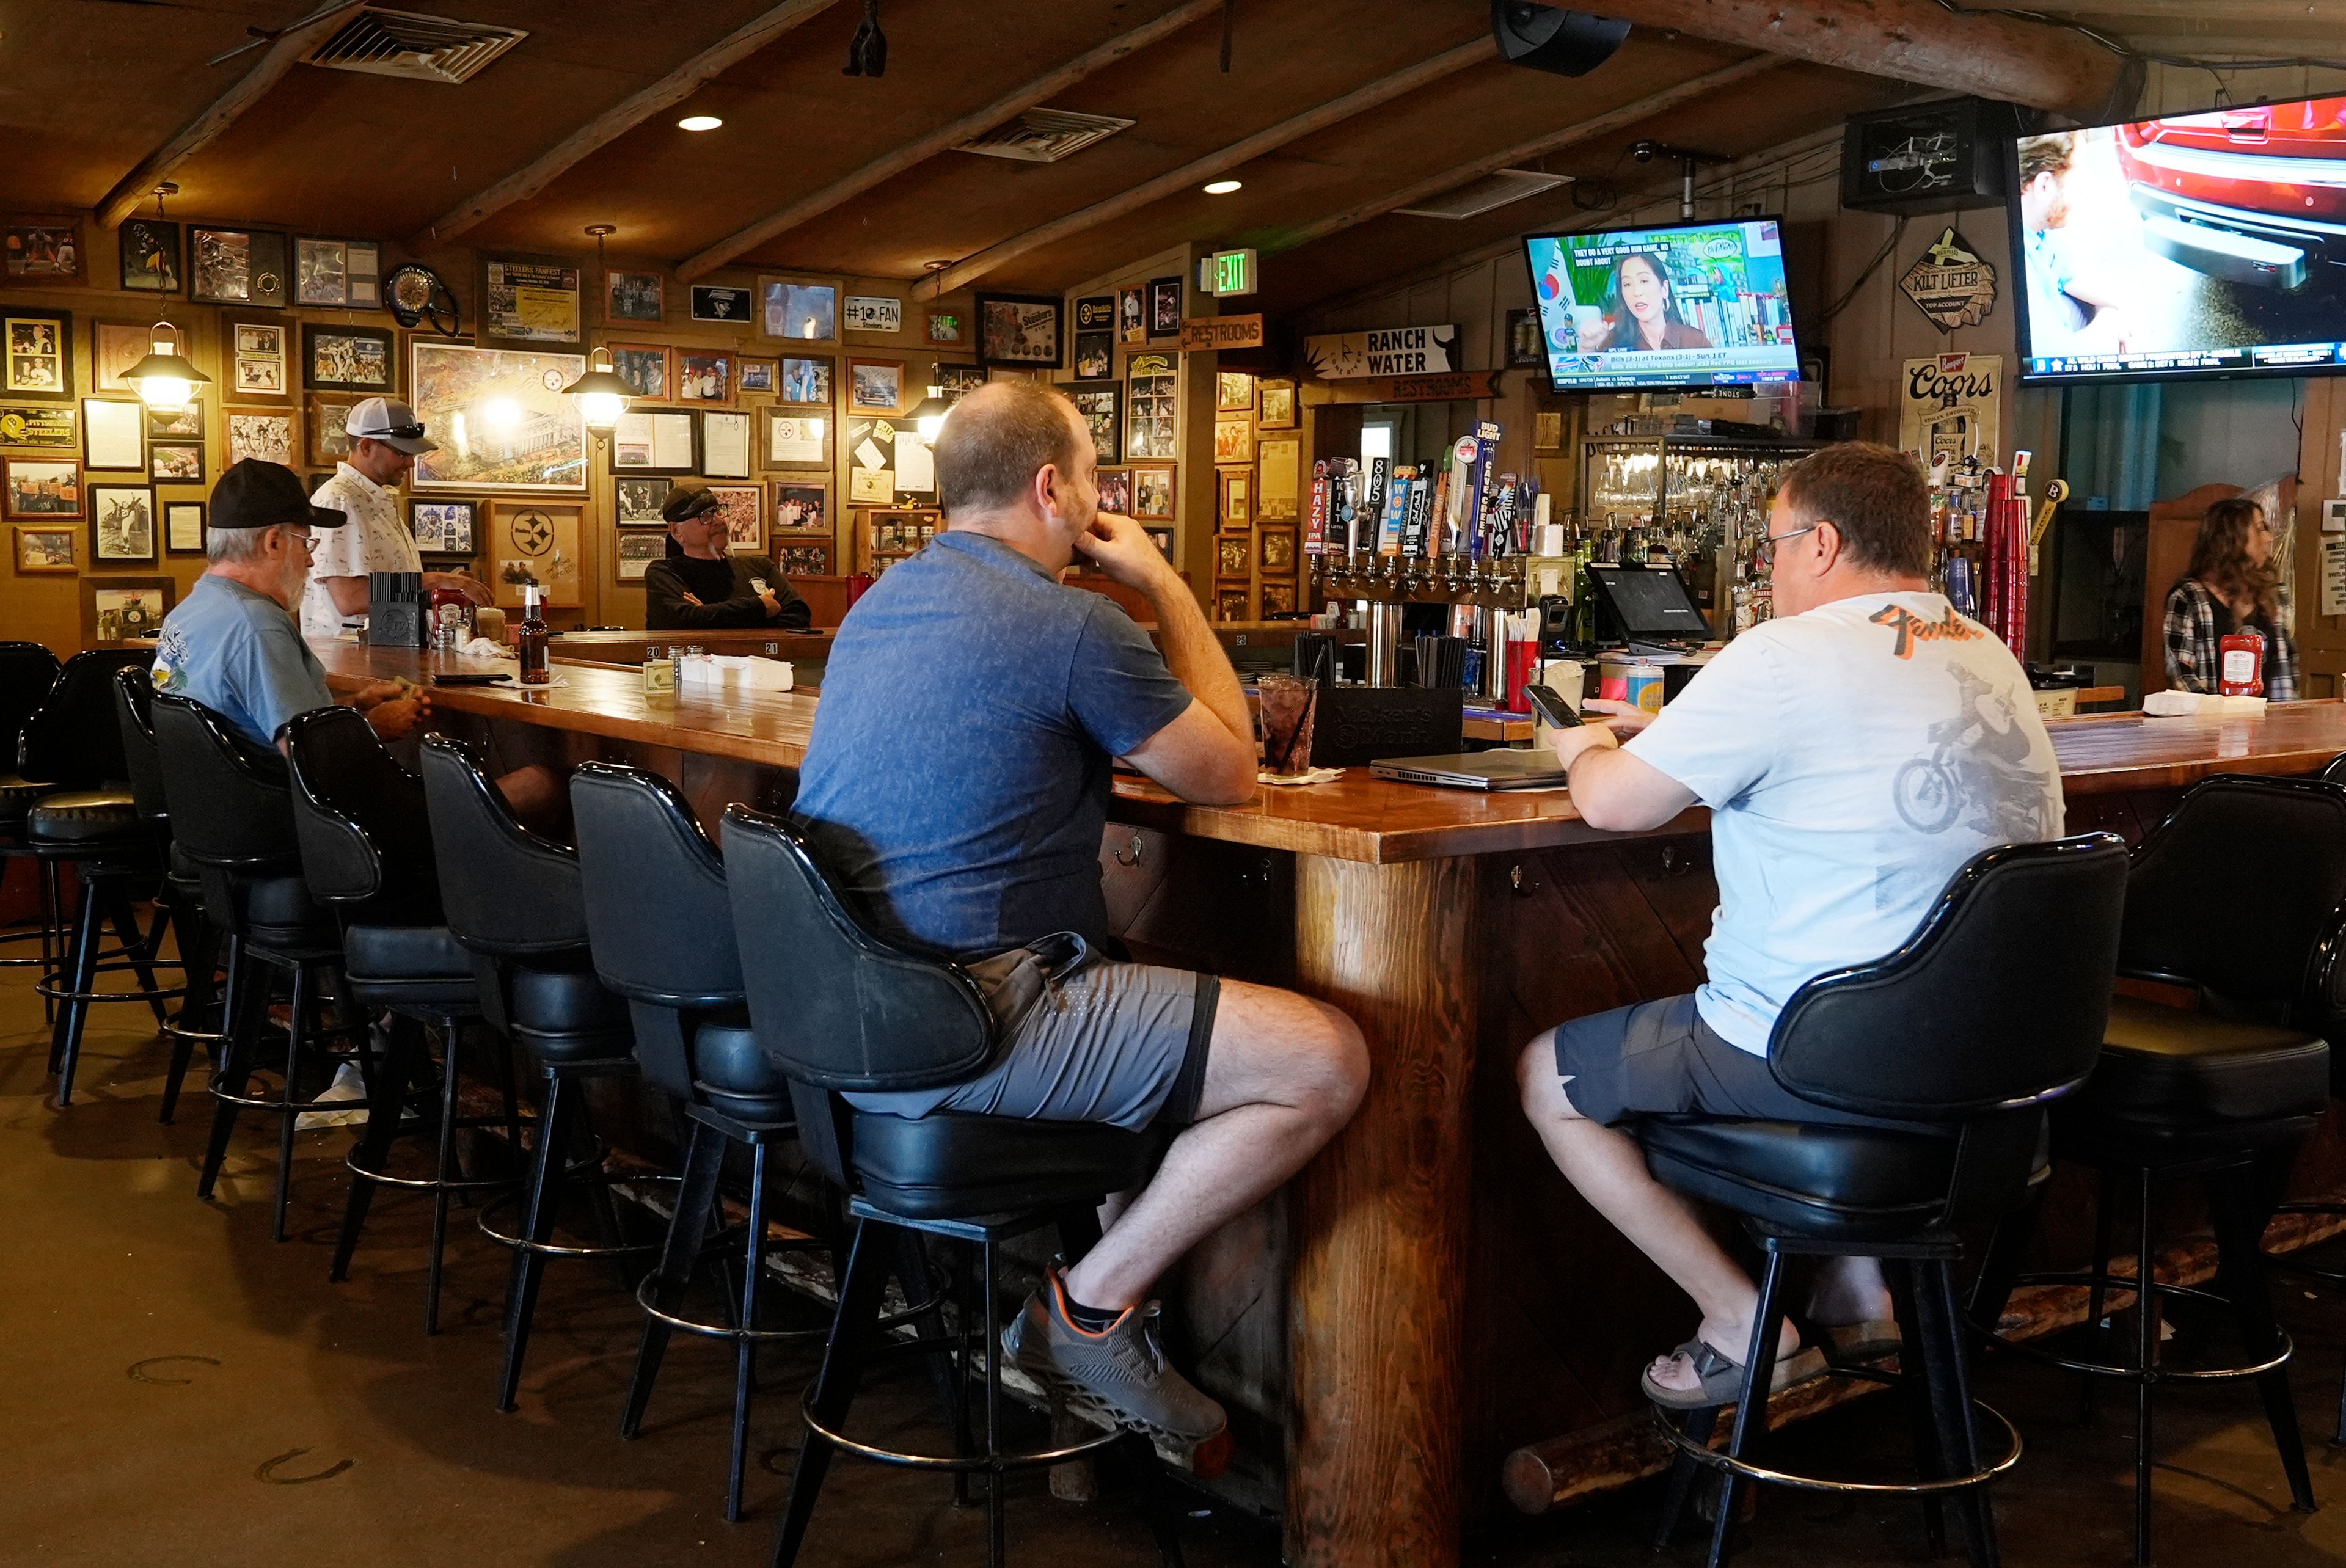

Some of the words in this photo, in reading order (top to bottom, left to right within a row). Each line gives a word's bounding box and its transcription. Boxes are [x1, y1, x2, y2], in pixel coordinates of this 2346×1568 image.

[1575, 258, 1593, 267] DOUBT
[1219, 253, 1245, 292] EXIT
[1913, 274, 1939, 291] KILT
[1941, 272, 1978, 290] LIFTER
[847, 305, 866, 321] #1
[880, 307, 898, 322] FAN
[1022, 309, 1053, 326] Steelers
[1191, 322, 1259, 343] RESTROOMS
[1368, 329, 1426, 352] RANCH
[1367, 352, 1427, 374] WATER
[2077, 356, 2096, 364] WILD
[2096, 355, 2117, 363] CARD
[2177, 358, 2193, 366] HOU
[1394, 377, 1471, 397] RESTROOMS
[1910, 364, 1993, 399] Coors
[26, 427, 70, 436] STEELERS
[1477, 429, 1501, 441] LIGHT
[1481, 422, 1499, 432] BUD
[1935, 436, 1956, 445] Coors
[1371, 460, 1384, 502] 805
[1483, 461, 1492, 494] CAVE
[2047, 484, 2059, 497] B
[1311, 483, 1323, 529] HAZY
[1335, 481, 1344, 523] KILT
[1477, 496, 1488, 538] CREEK
[1868, 603, 1985, 660] Fender
[648, 647, 659, 657] 20
[766, 644, 777, 653] 21
